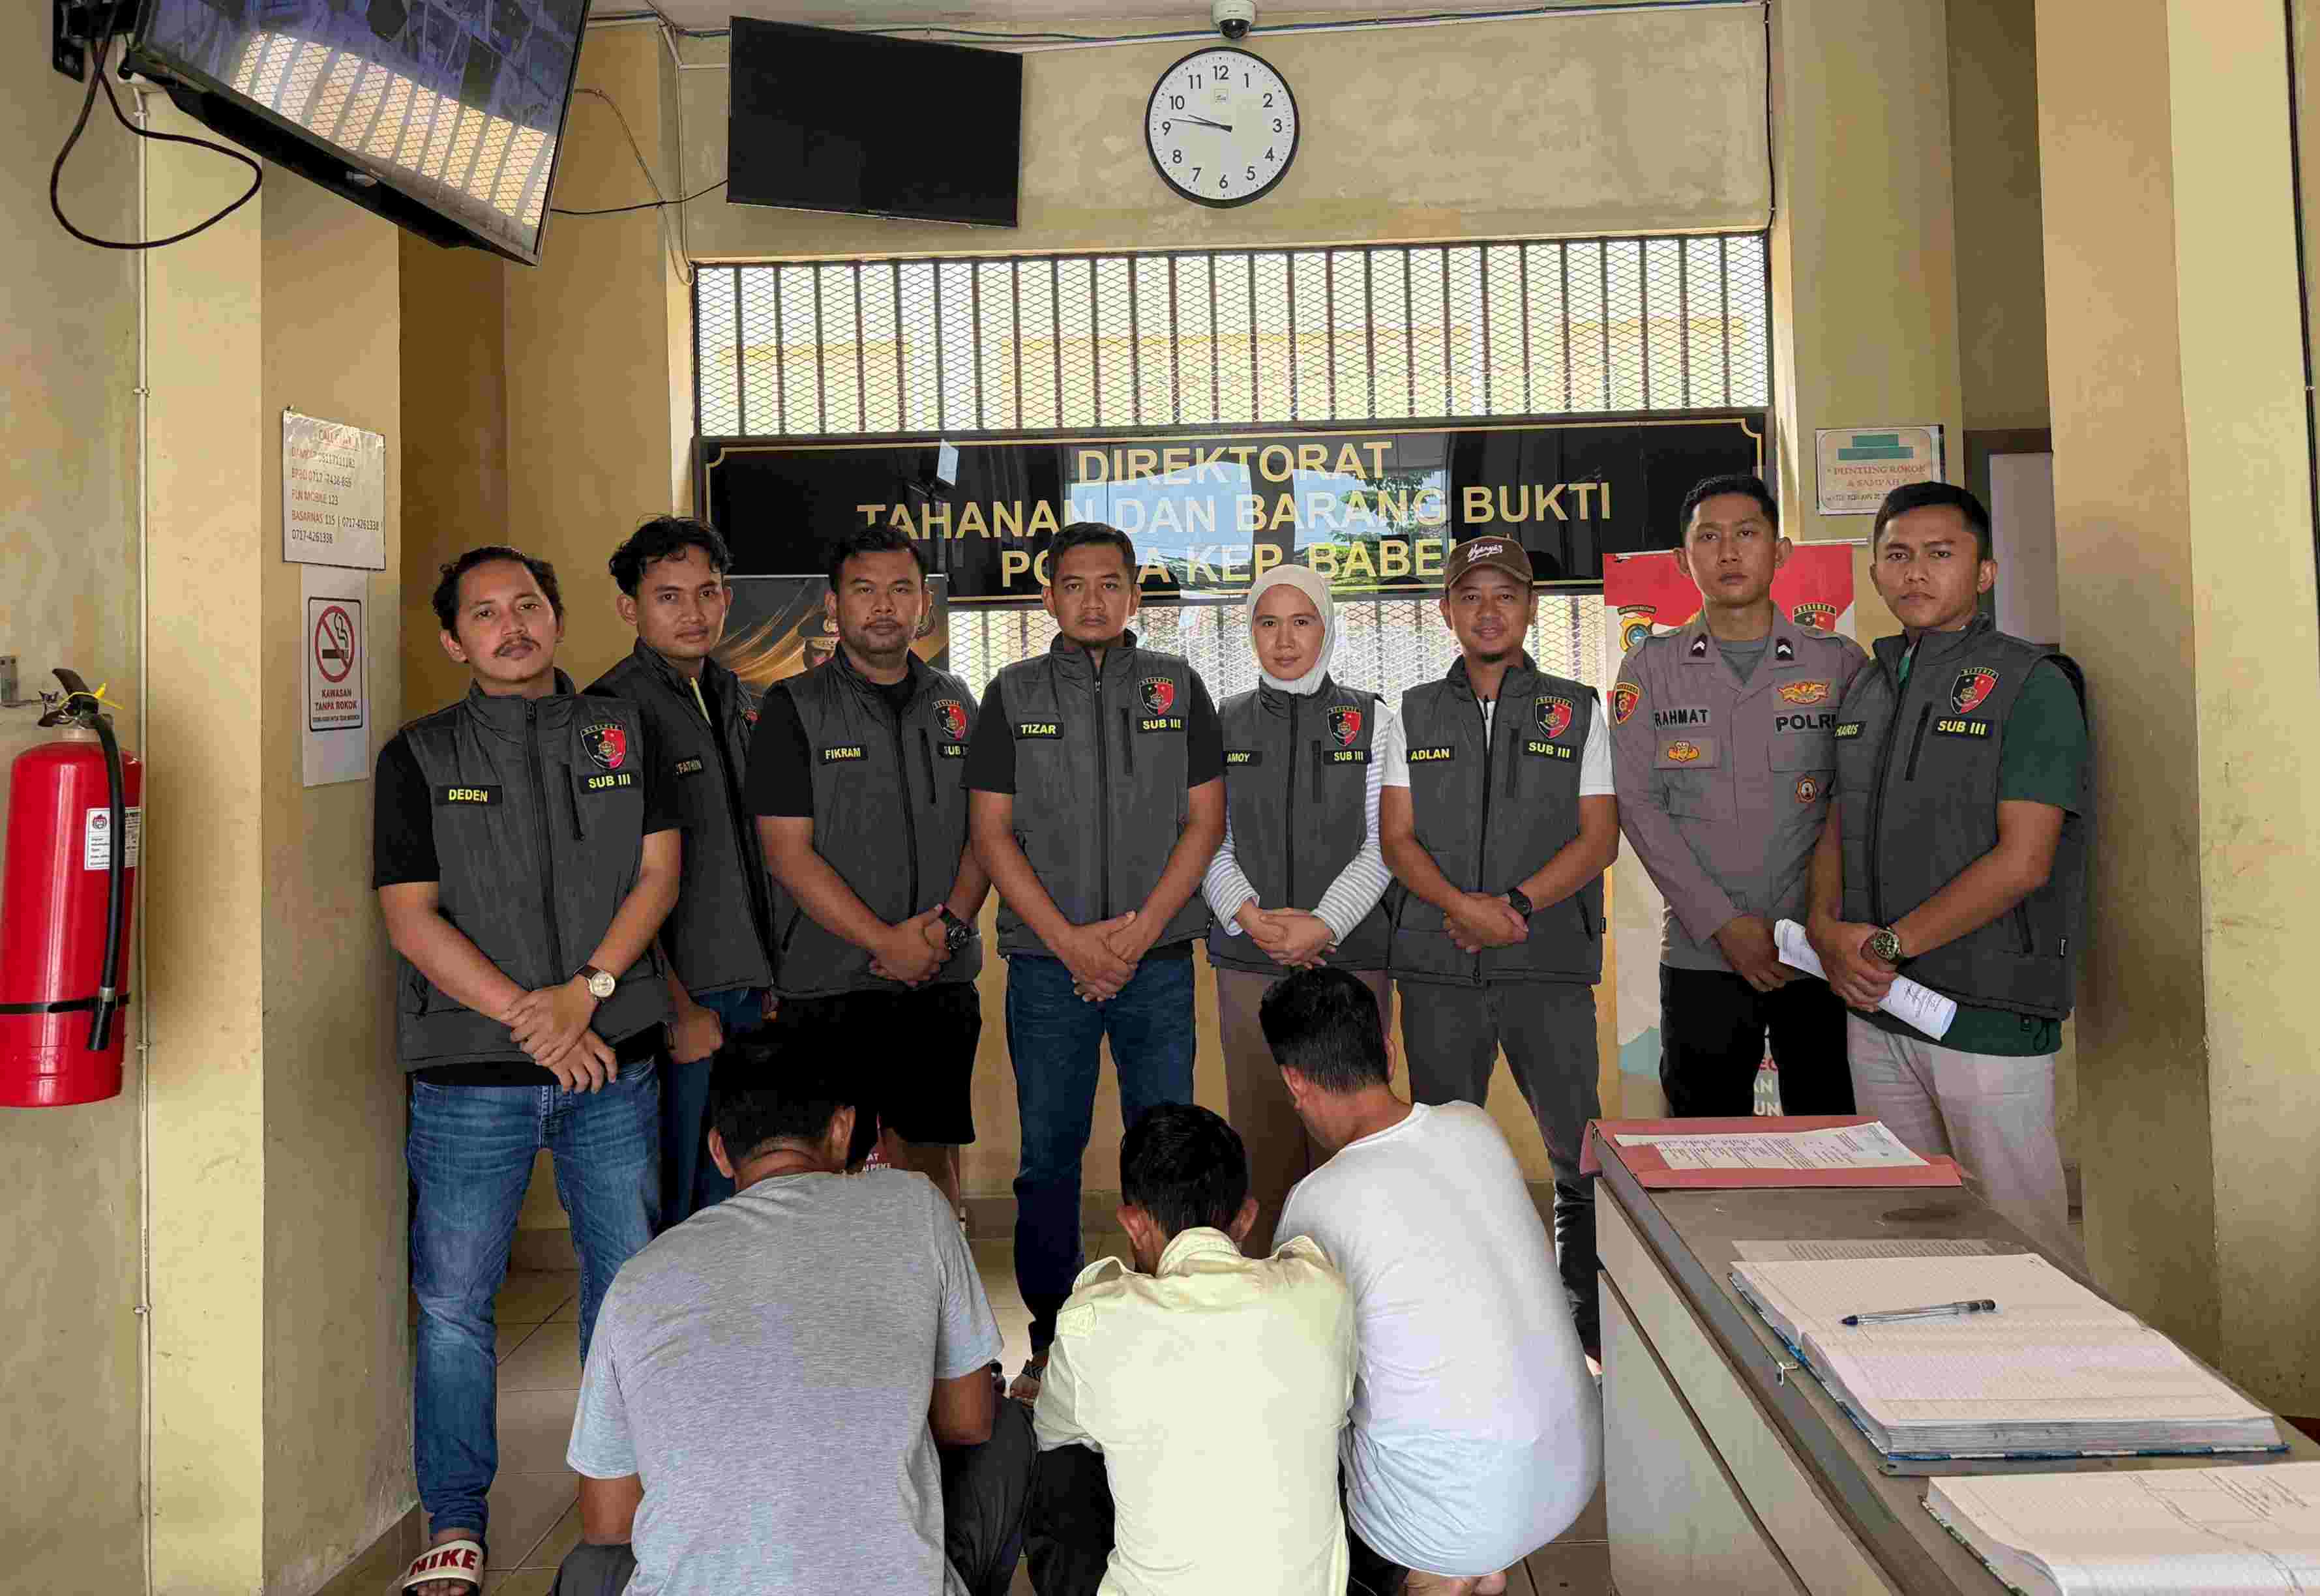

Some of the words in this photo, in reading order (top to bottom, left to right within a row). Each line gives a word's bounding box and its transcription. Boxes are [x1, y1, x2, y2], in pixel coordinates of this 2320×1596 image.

[1212, 65, 1230, 80] 12
[1188, 74, 1202, 89] 11
[1243, 72, 1250, 89] 1
[1169, 95, 1185, 110] 10
[1262, 93, 1273, 108] 2
[1161, 121, 1171, 136] 9
[1272, 118, 1283, 133] 3
[1172, 149, 1182, 164] 8
[1264, 146, 1275, 162] 4
[1192, 167, 1202, 182] 7
[1245, 166, 1256, 181] 5
[1219, 174, 1228, 189] 6
[1077, 441, 1393, 484] DIREKTORAT
[328, 495, 338, 506] 123
[291, 509, 323, 524] BASARNAS
[856, 499, 1097, 540] TAHANAN
[1115, 495, 1216, 533] DAN
[1236, 488, 1450, 532] BARANG
[1463, 482, 1612, 524] BUKTI
[321, 688, 352, 698] KAWASAN
[314, 701, 335, 711] TANPA
[336, 700, 358, 710] ROKOK
[1142, 718, 1167, 730] SUB
[1654, 709, 1708, 727] RAHMAT
[1020, 724, 1056, 735] TIZAR
[1937, 720, 1966, 733] SUB
[1969, 722, 1987, 735] III
[1333, 752, 1352, 762] SUB
[1410, 748, 1450, 761] ADLAN
[1528, 741, 1554, 756] SUB
[1557, 746, 1571, 759] III
[588, 775, 615, 790] SUB
[617, 773, 631, 786] III
[448, 788, 488, 803] DEDEN
[409, 1548, 478, 1577] NIKE
